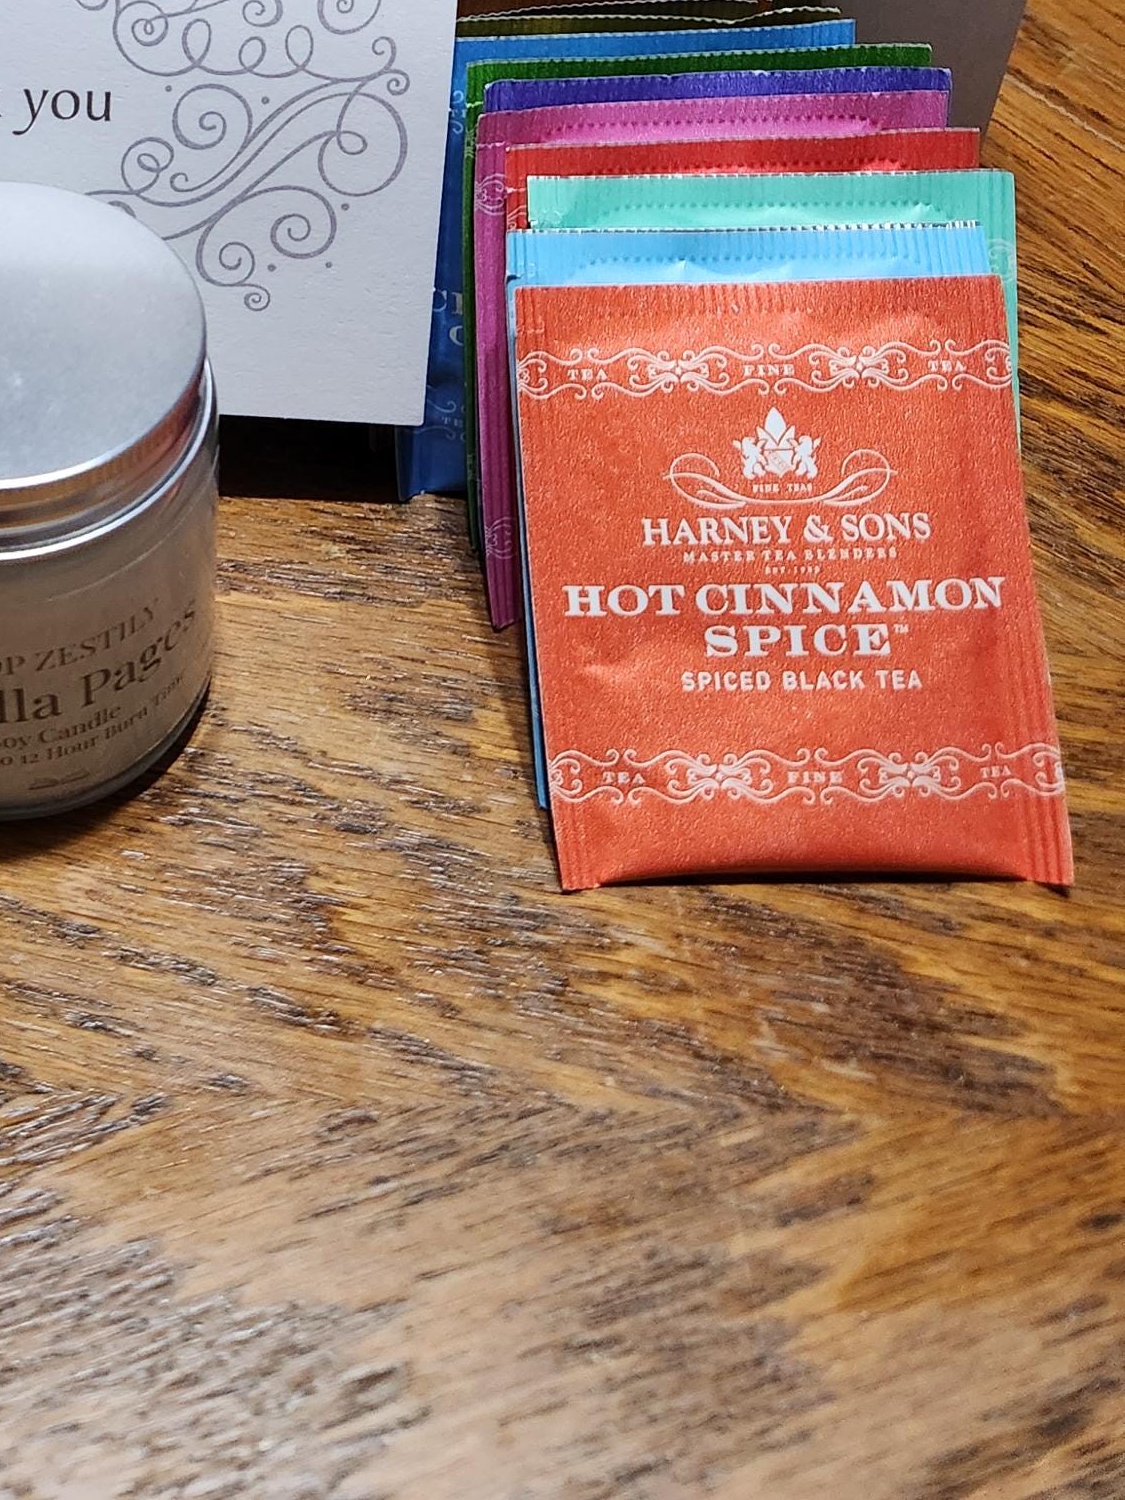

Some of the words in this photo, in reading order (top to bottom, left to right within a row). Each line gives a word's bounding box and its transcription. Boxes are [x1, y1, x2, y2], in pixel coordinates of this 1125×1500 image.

[12, 88, 112, 136] you
[567, 368, 608, 382] TEA
[743, 363, 795, 377] FINE
[928, 359, 967, 373] TEA
[641, 514, 792, 546] HARNEY
[803, 514, 834, 543] &
[841, 511, 931, 542] SONS
[683, 550, 756, 564] MASTER
[762, 549, 796, 562] TEA
[804, 547, 898, 561] BLENDERS
[562, 583, 685, 618] HOT
[695, 576, 1006, 617] CINNAMON
[681, 669, 770, 692] SPICED
[782, 669, 865, 692] BLACK
[876, 669, 923, 690] TEA
[39, 705, 122, 743] Candle
[602, 772, 646, 786] TEA
[787, 770, 845, 786] FINE
[980, 765, 1012, 778] TEA
